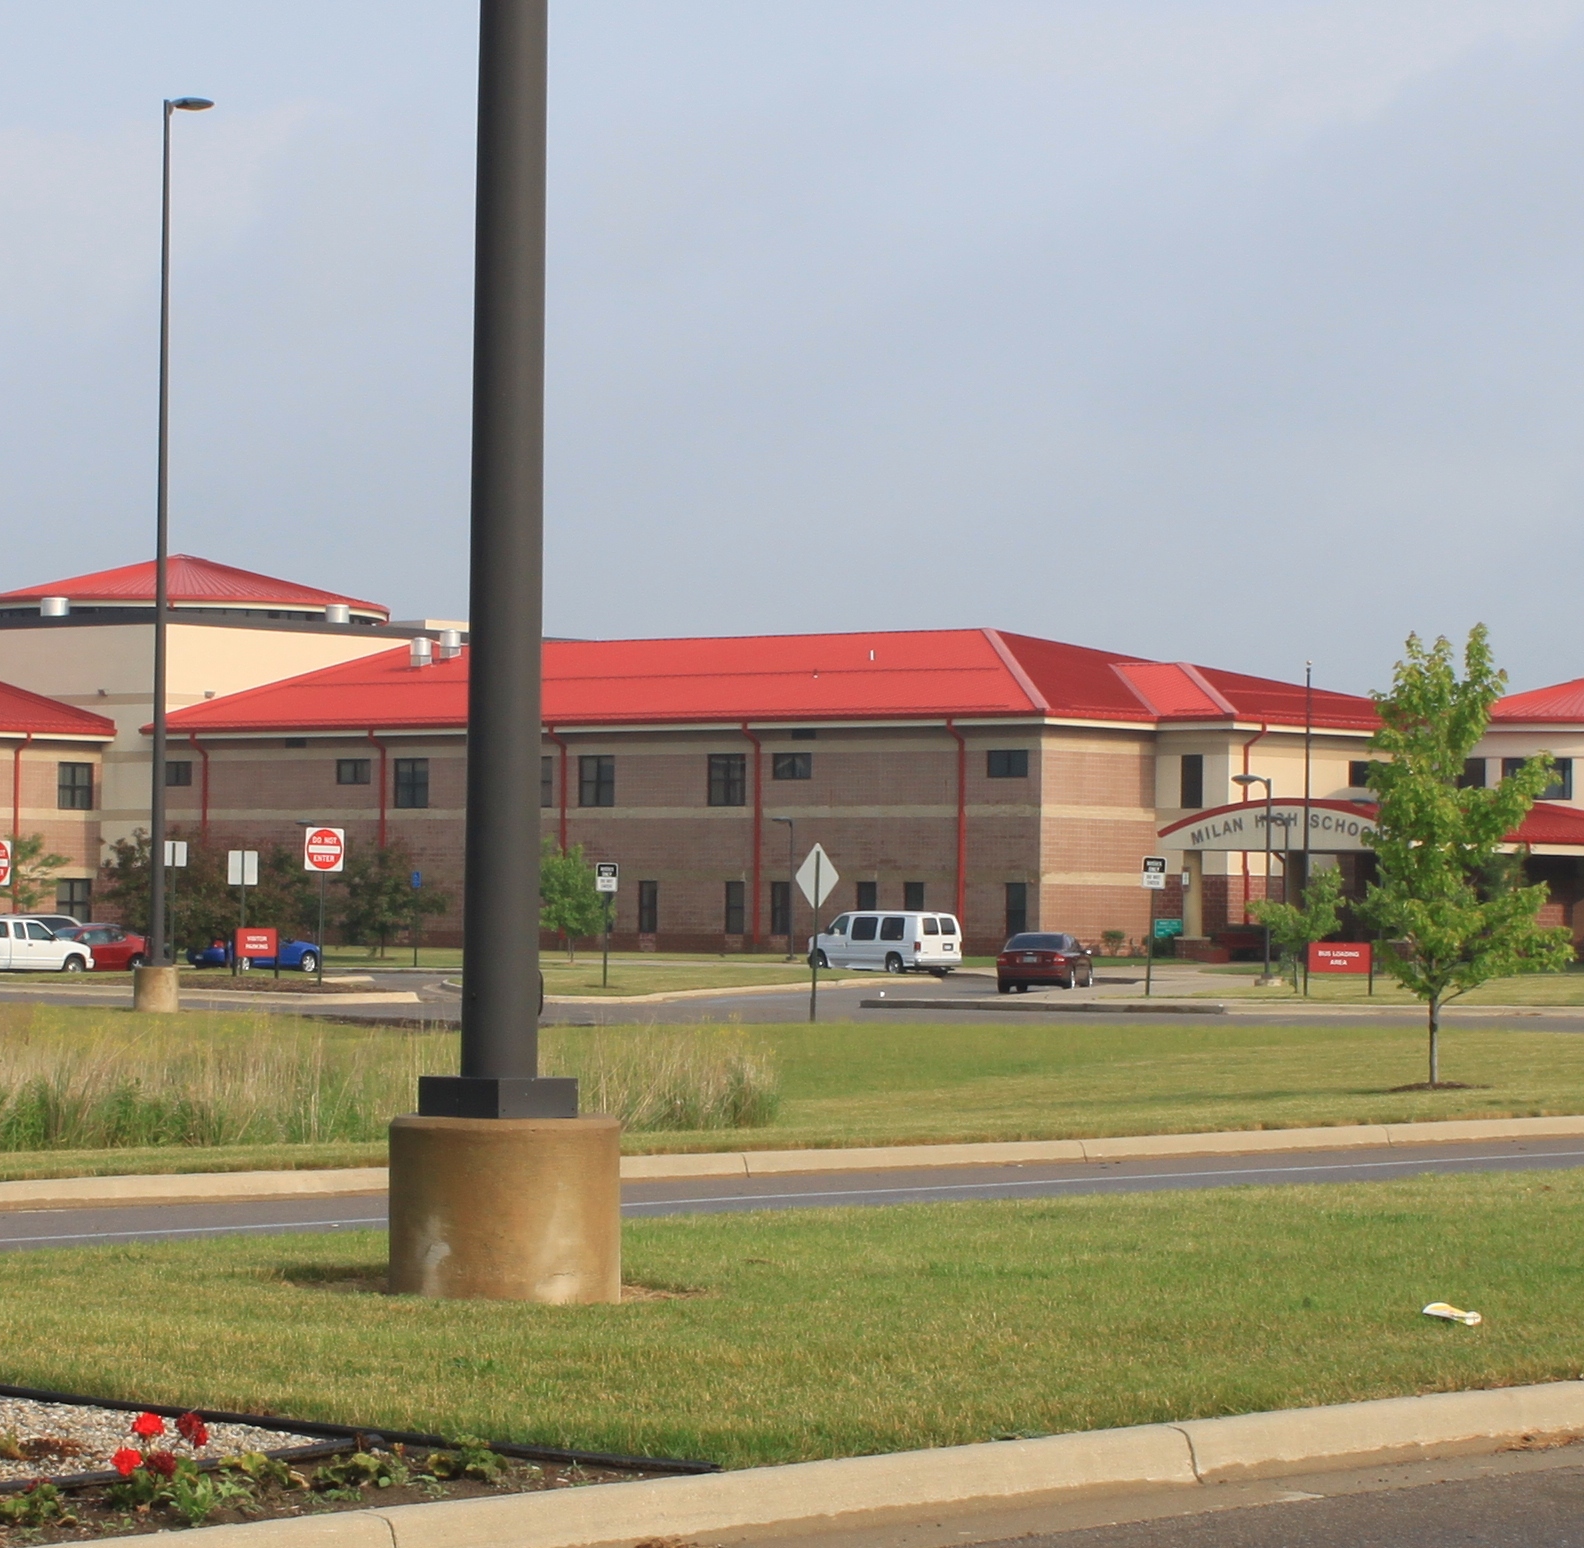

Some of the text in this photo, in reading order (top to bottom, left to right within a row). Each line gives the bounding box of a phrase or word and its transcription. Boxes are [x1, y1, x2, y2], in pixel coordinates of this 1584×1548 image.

[1190, 817, 1244, 846] MILAN
[1255, 812, 1297, 828] HGH
[313, 854, 335, 862] ENTER
[1332, 950, 1360, 958] LOADING
